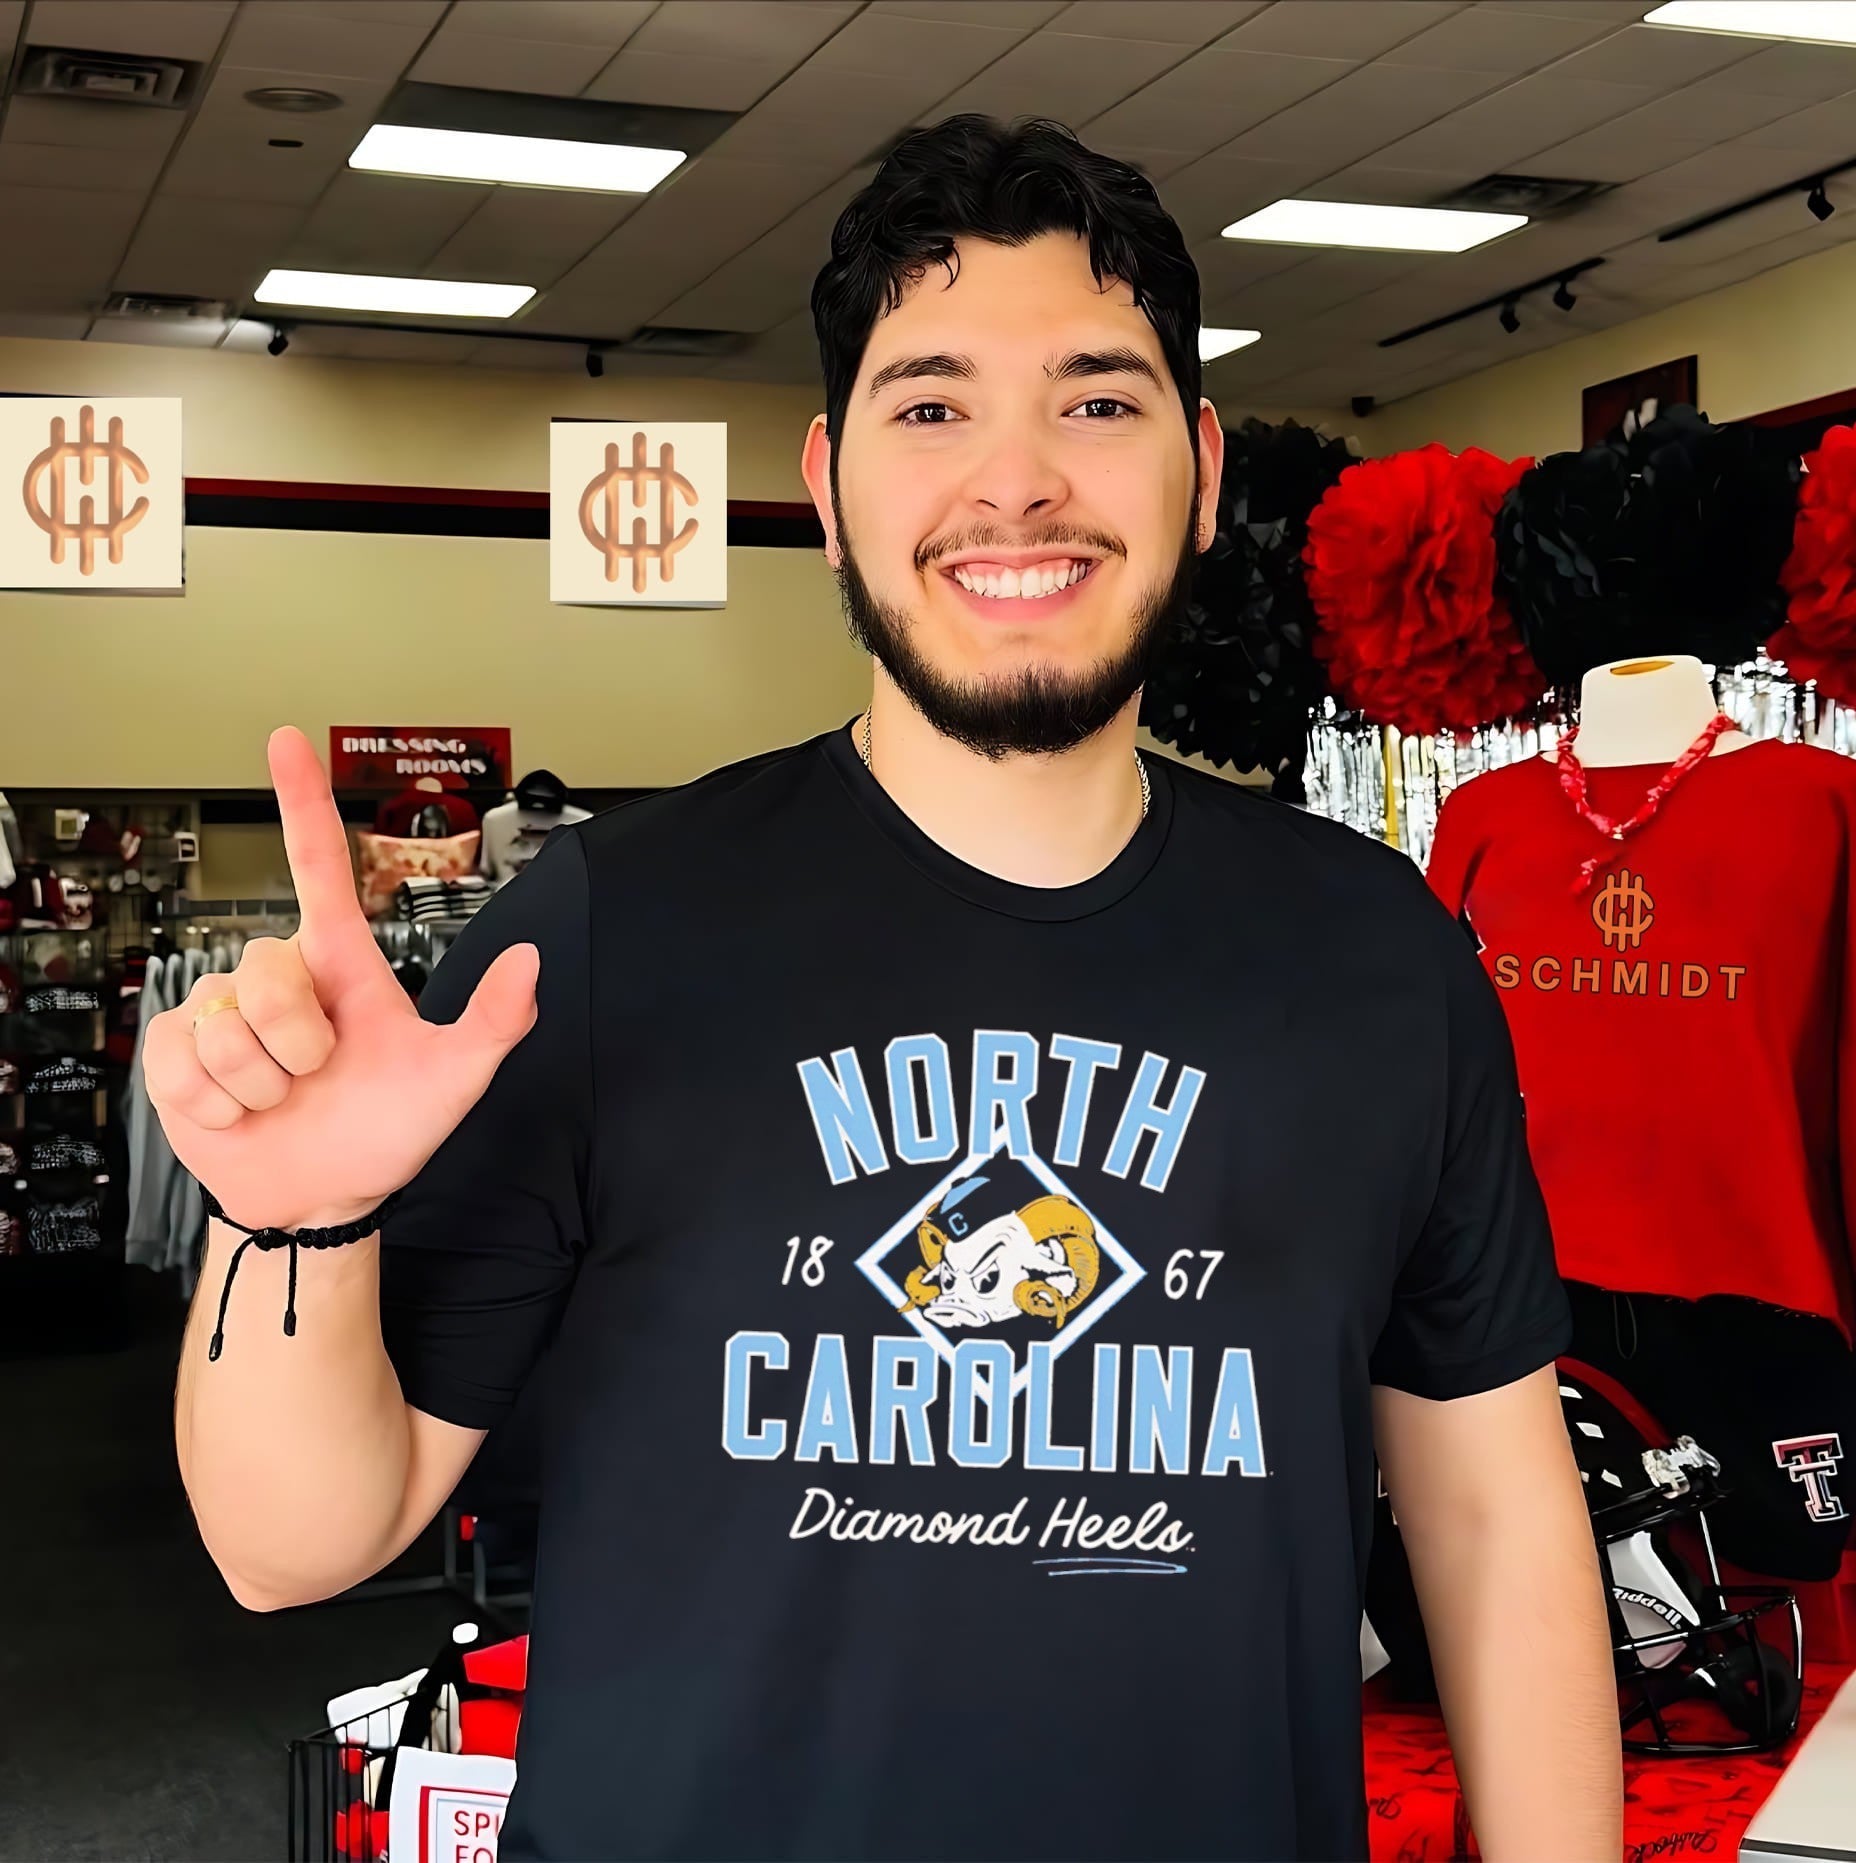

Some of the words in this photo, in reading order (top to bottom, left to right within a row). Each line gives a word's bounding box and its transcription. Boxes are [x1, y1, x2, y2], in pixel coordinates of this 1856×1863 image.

[1494, 954, 1746, 1000] SCHMIDT
[797, 1029, 1206, 1193] NORTH
[948, 1212, 969, 1236] C
[781, 1235, 834, 1287] 18
[1163, 1249, 1224, 1300] 67
[721, 1330, 1267, 1478] CAROLINA
[789, 1487, 1030, 1548] Diamond
